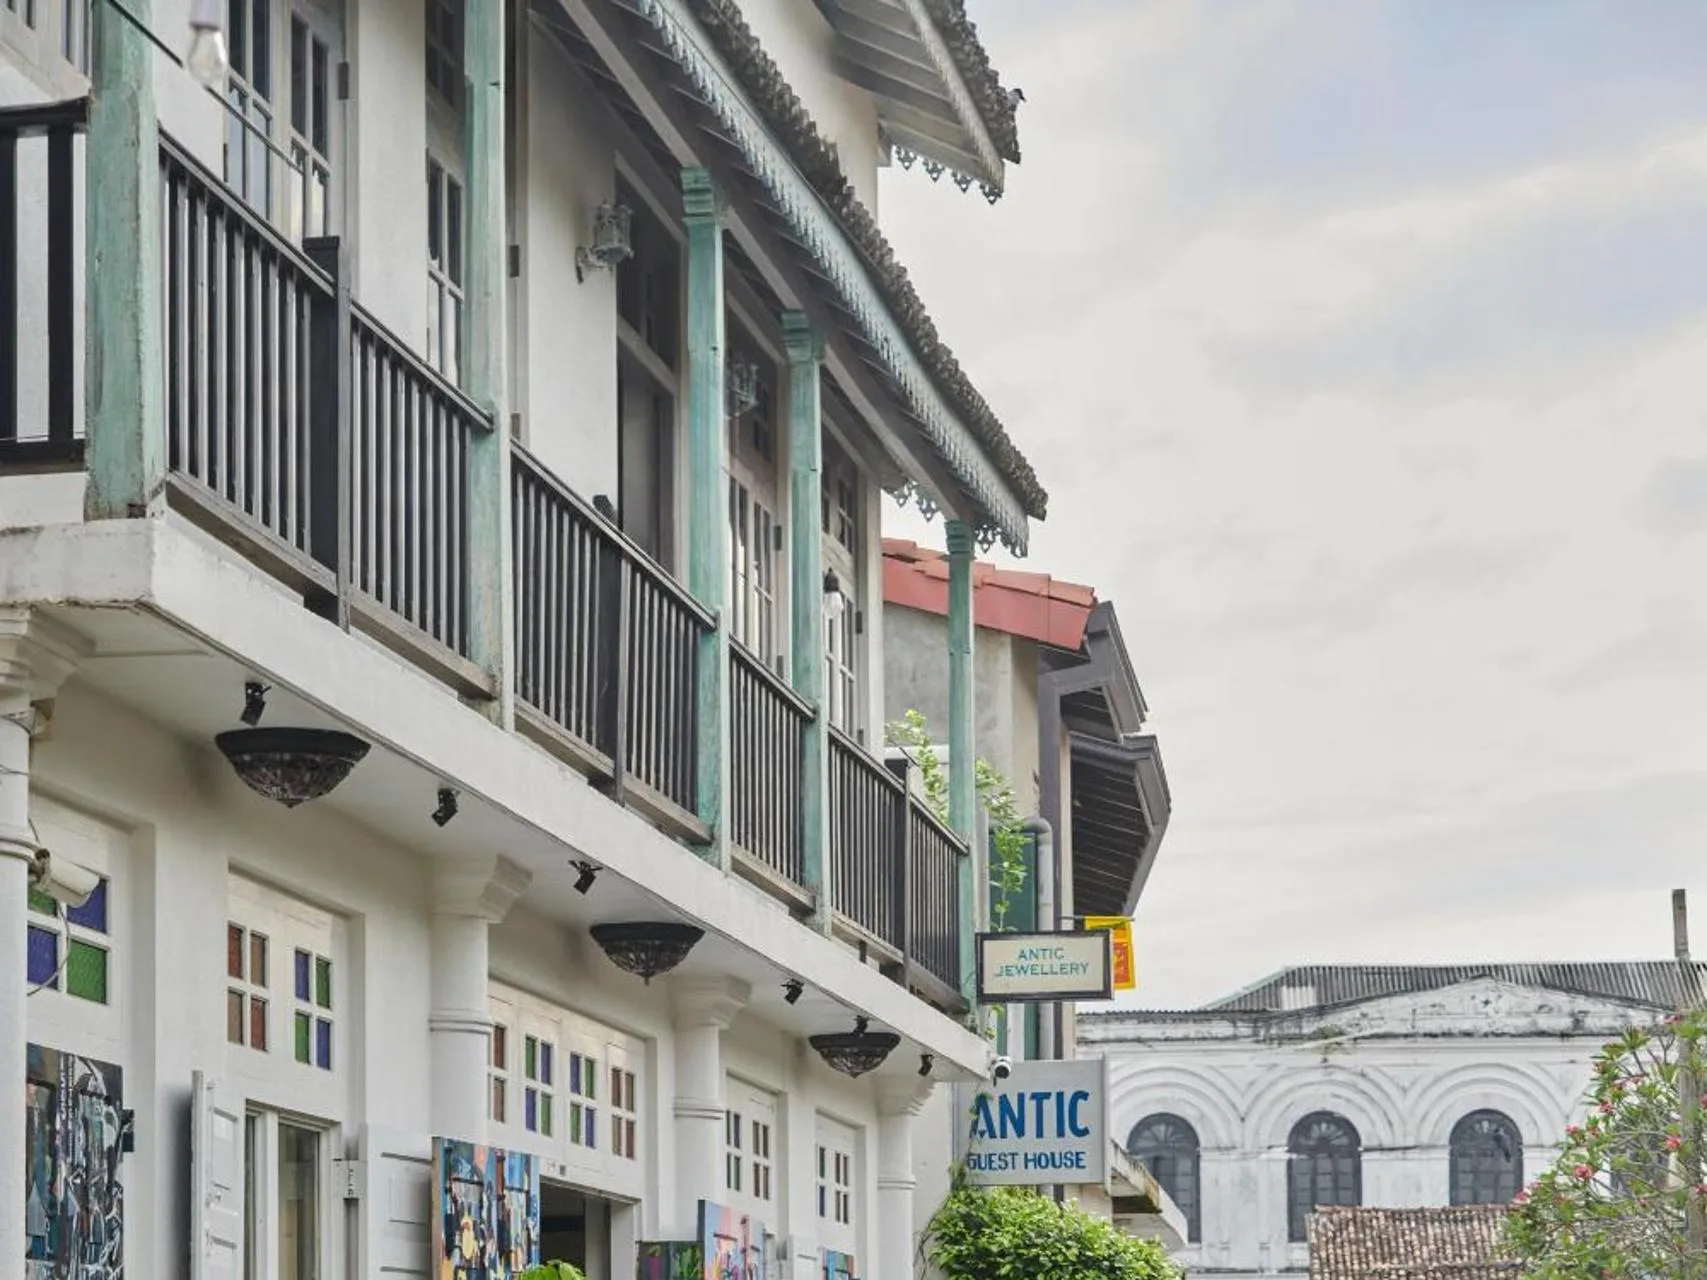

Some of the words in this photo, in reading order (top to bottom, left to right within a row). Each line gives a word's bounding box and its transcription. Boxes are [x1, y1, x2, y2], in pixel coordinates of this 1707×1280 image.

[1018, 947, 1065, 960] ANTIC
[995, 962, 1089, 977] JEWELLERY
[970, 1091, 1090, 1139] ANTIC
[966, 1152, 1018, 1170] GUEST
[1024, 1151, 1086, 1169] HOUSE
